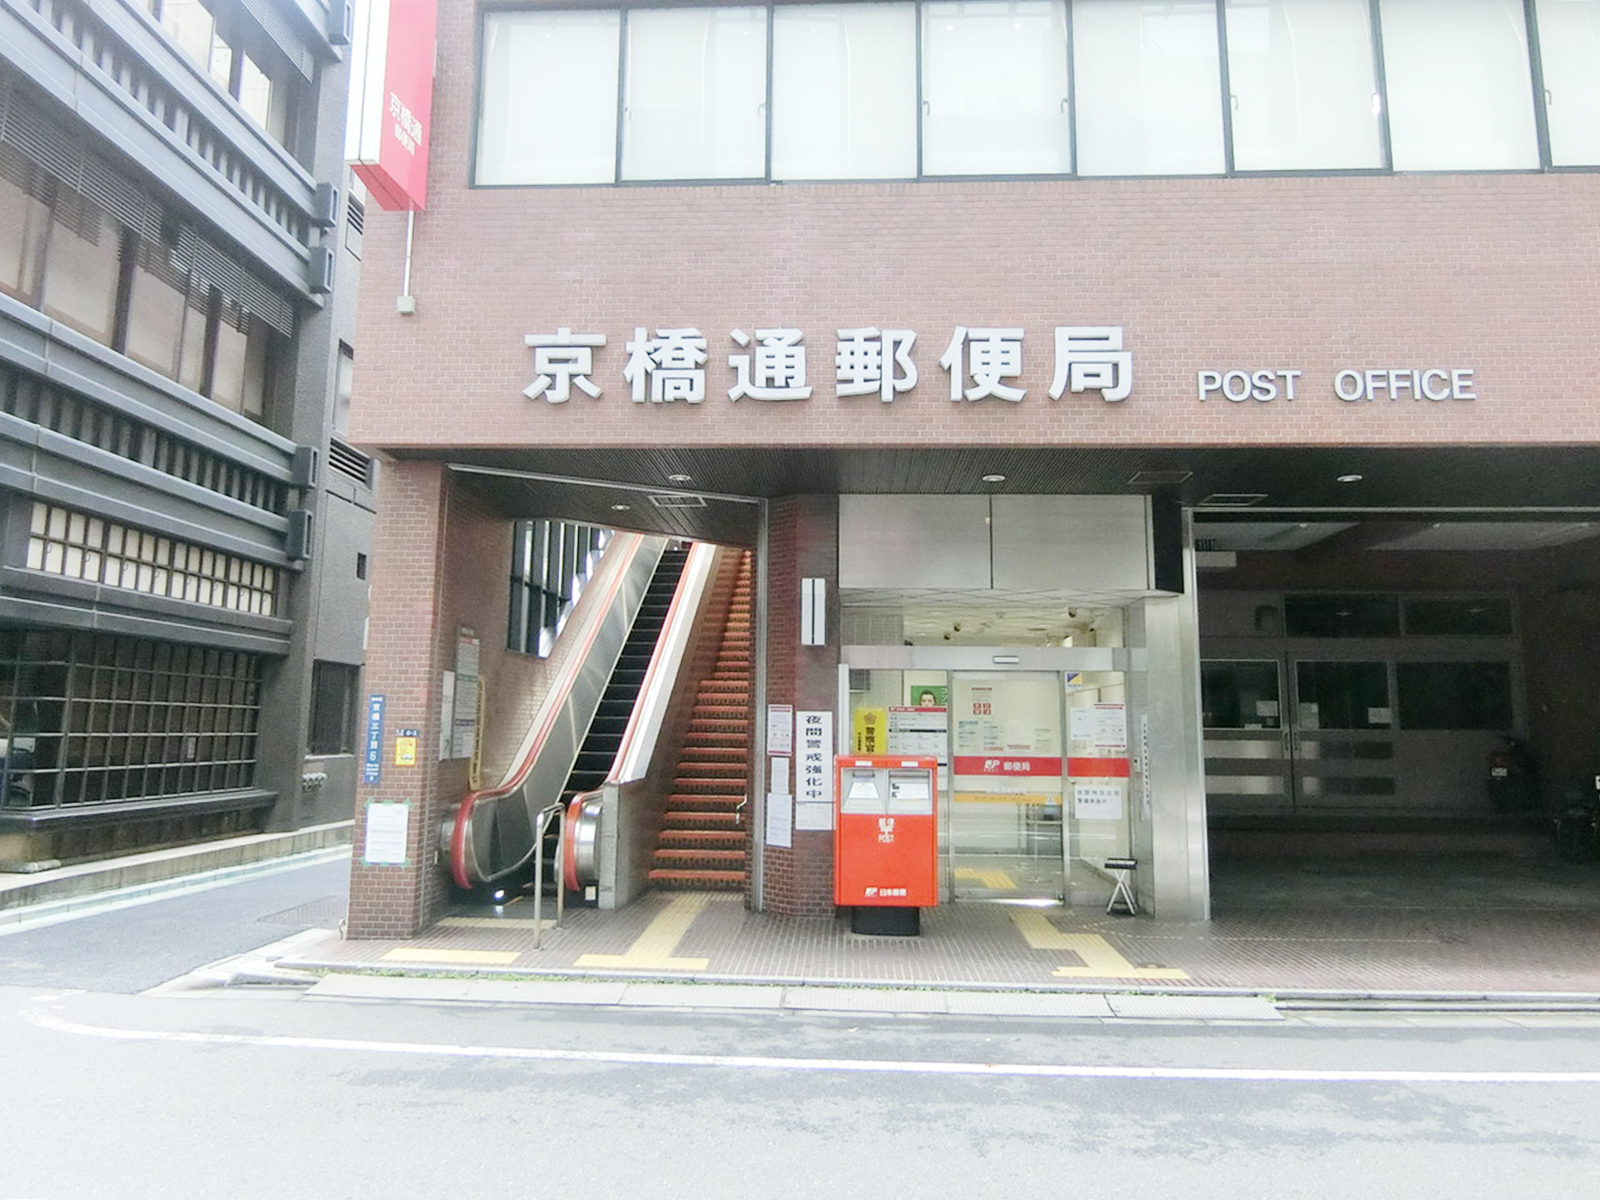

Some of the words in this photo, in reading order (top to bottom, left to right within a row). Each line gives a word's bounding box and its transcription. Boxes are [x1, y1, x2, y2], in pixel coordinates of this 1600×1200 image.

[389, 91, 422, 147] 京橋通
[522, 325, 1133, 404] 京橋通郵便局
[1197, 369, 1301, 402] POST
[1334, 368, 1477, 402] OFFICE
[805, 715, 822, 799] 夜間警戒強化中
[1003, 761, 1031, 771] 郵便局
[878, 834, 894, 843] POST
